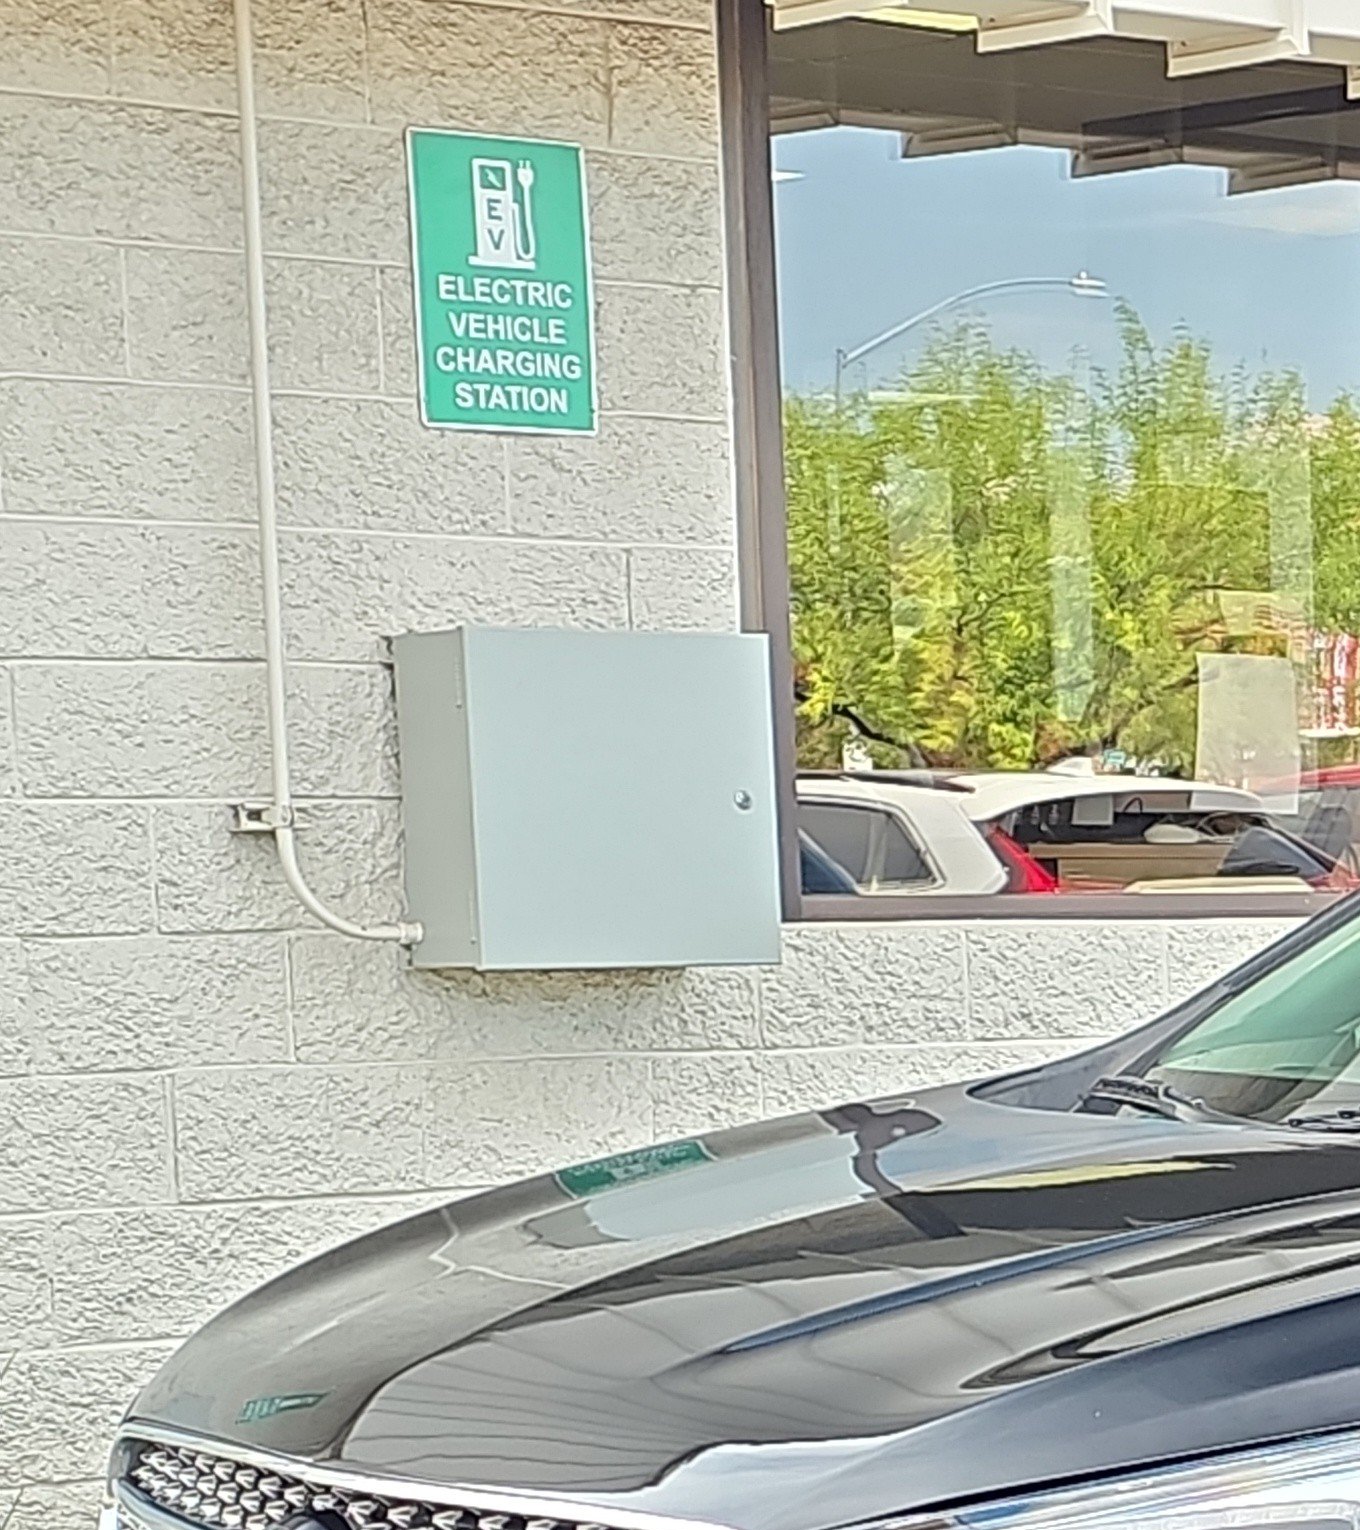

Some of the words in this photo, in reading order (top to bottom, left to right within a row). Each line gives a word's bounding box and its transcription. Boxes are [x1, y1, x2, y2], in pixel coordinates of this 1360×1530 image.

[486, 198, 506, 251] EV
[437, 273, 573, 309] ELECTRIC
[447, 311, 568, 345] VEHICLE
[435, 346, 583, 380] CHARGING
[454, 381, 569, 414] STATION
